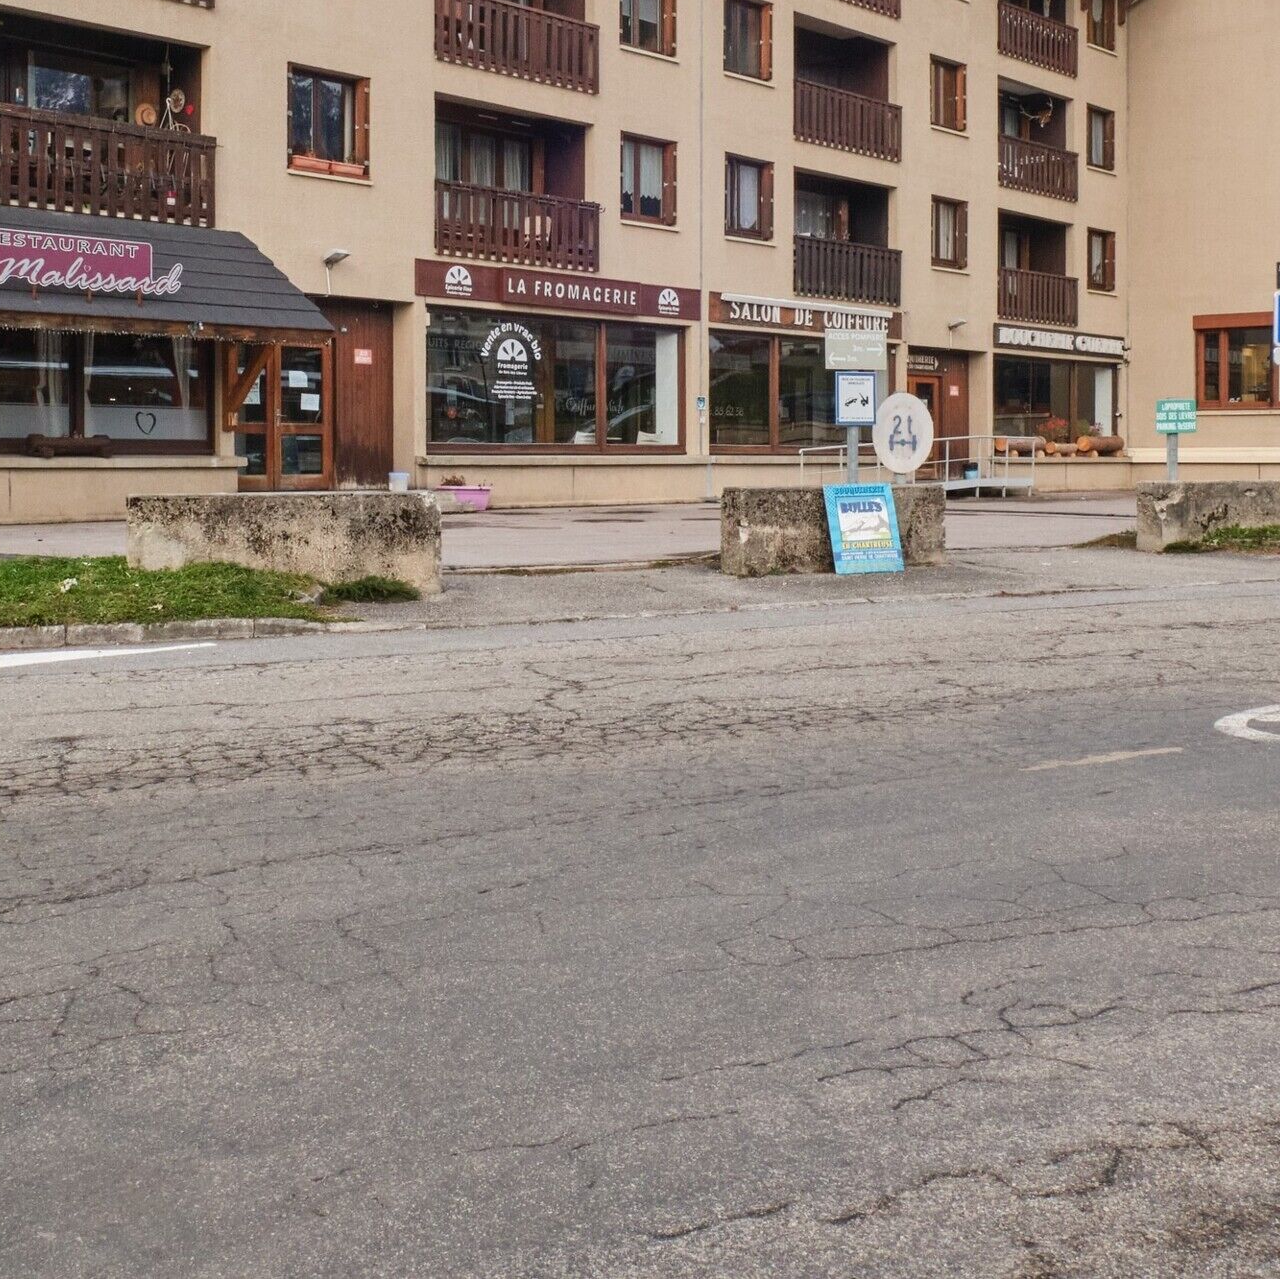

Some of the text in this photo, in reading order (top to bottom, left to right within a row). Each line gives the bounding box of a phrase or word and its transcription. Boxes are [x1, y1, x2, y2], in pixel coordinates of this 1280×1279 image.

[507, 278, 637, 306] LA FROMAGERIE
[730, 302, 889, 333] SALON DE COIFFURE
[480, 322, 542, 361] Vente en vrac bio
[497, 362, 528, 371] Fromagerie
[840, 501, 883, 514] BULLES
